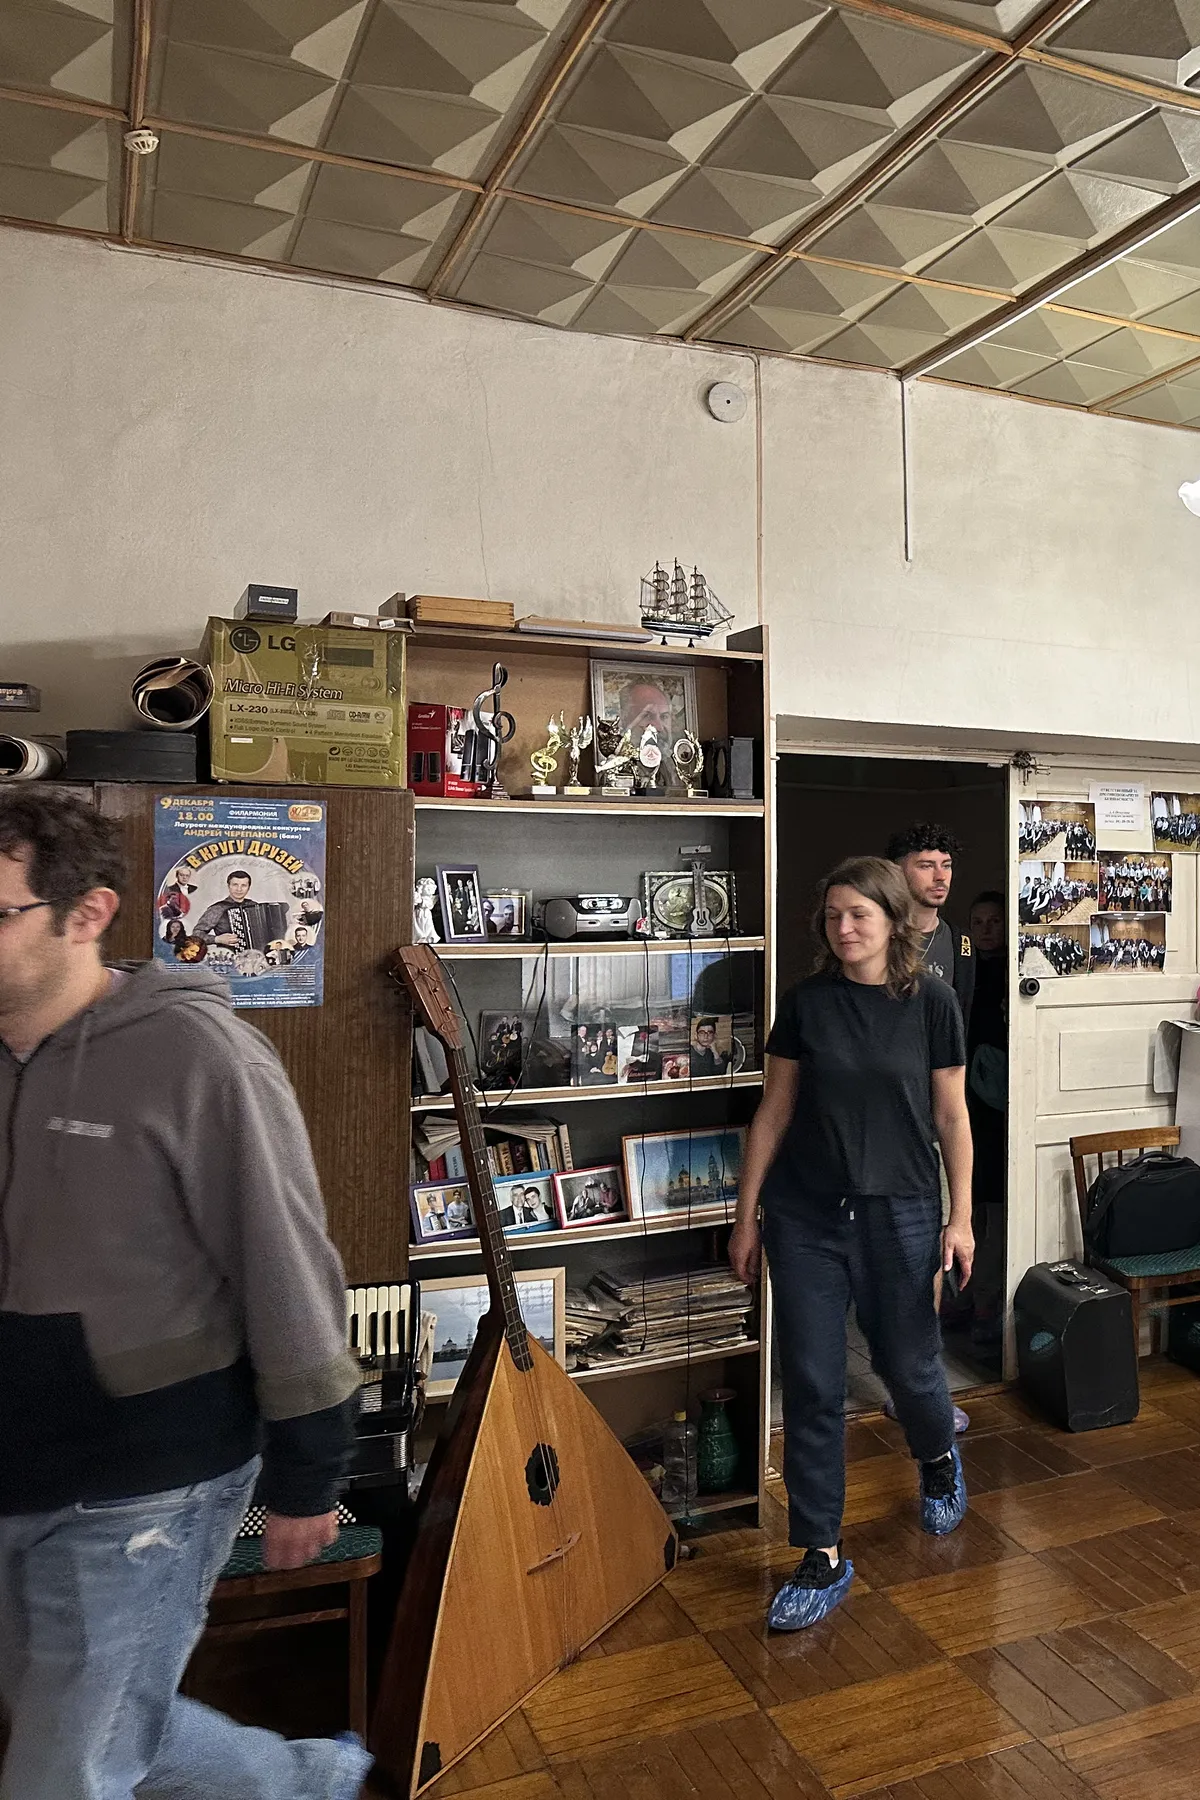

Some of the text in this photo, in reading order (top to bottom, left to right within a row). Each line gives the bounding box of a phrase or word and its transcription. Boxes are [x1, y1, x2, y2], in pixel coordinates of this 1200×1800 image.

[268, 635, 296, 651] LG
[224, 679, 344, 701] Micro Hi-Fi System
[229, 704, 269, 714] LX-230
[160, 797, 172, 809] 9
[172, 799, 214, 807] ДЕКАБРЯ
[177, 811, 214, 821] 18.00
[174, 821, 207, 829] Лауреат
[184, 829, 223, 837] АНДРЕЙ
[224, 831, 278, 839] ЧЕРЕПАНОВ
[186, 839, 305, 874] В КРУГУ ДРУЗЕЙ
